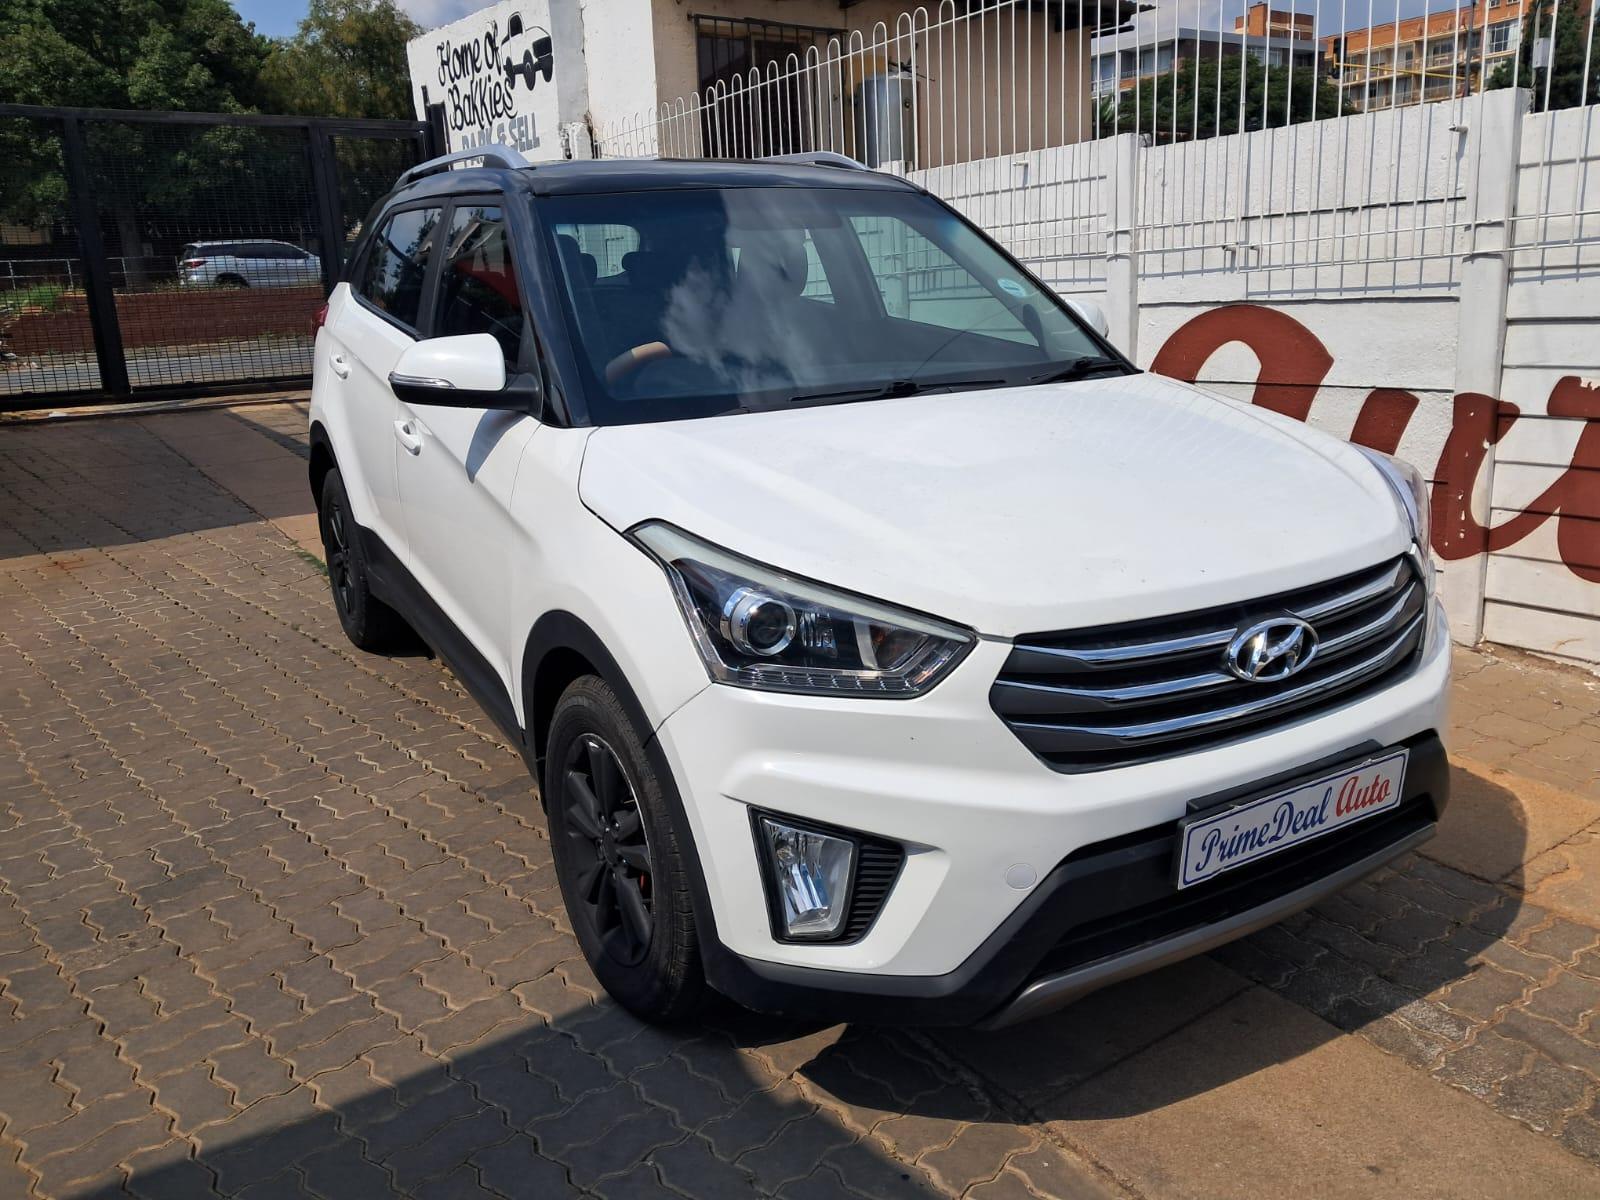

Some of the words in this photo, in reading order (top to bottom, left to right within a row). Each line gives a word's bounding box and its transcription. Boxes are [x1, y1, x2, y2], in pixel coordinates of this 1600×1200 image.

[436, 39, 482, 86] Home
[508, 112, 540, 152] SELL
[1195, 786, 1333, 872] PrimeDeal
[1335, 774, 1391, 817] Auto
